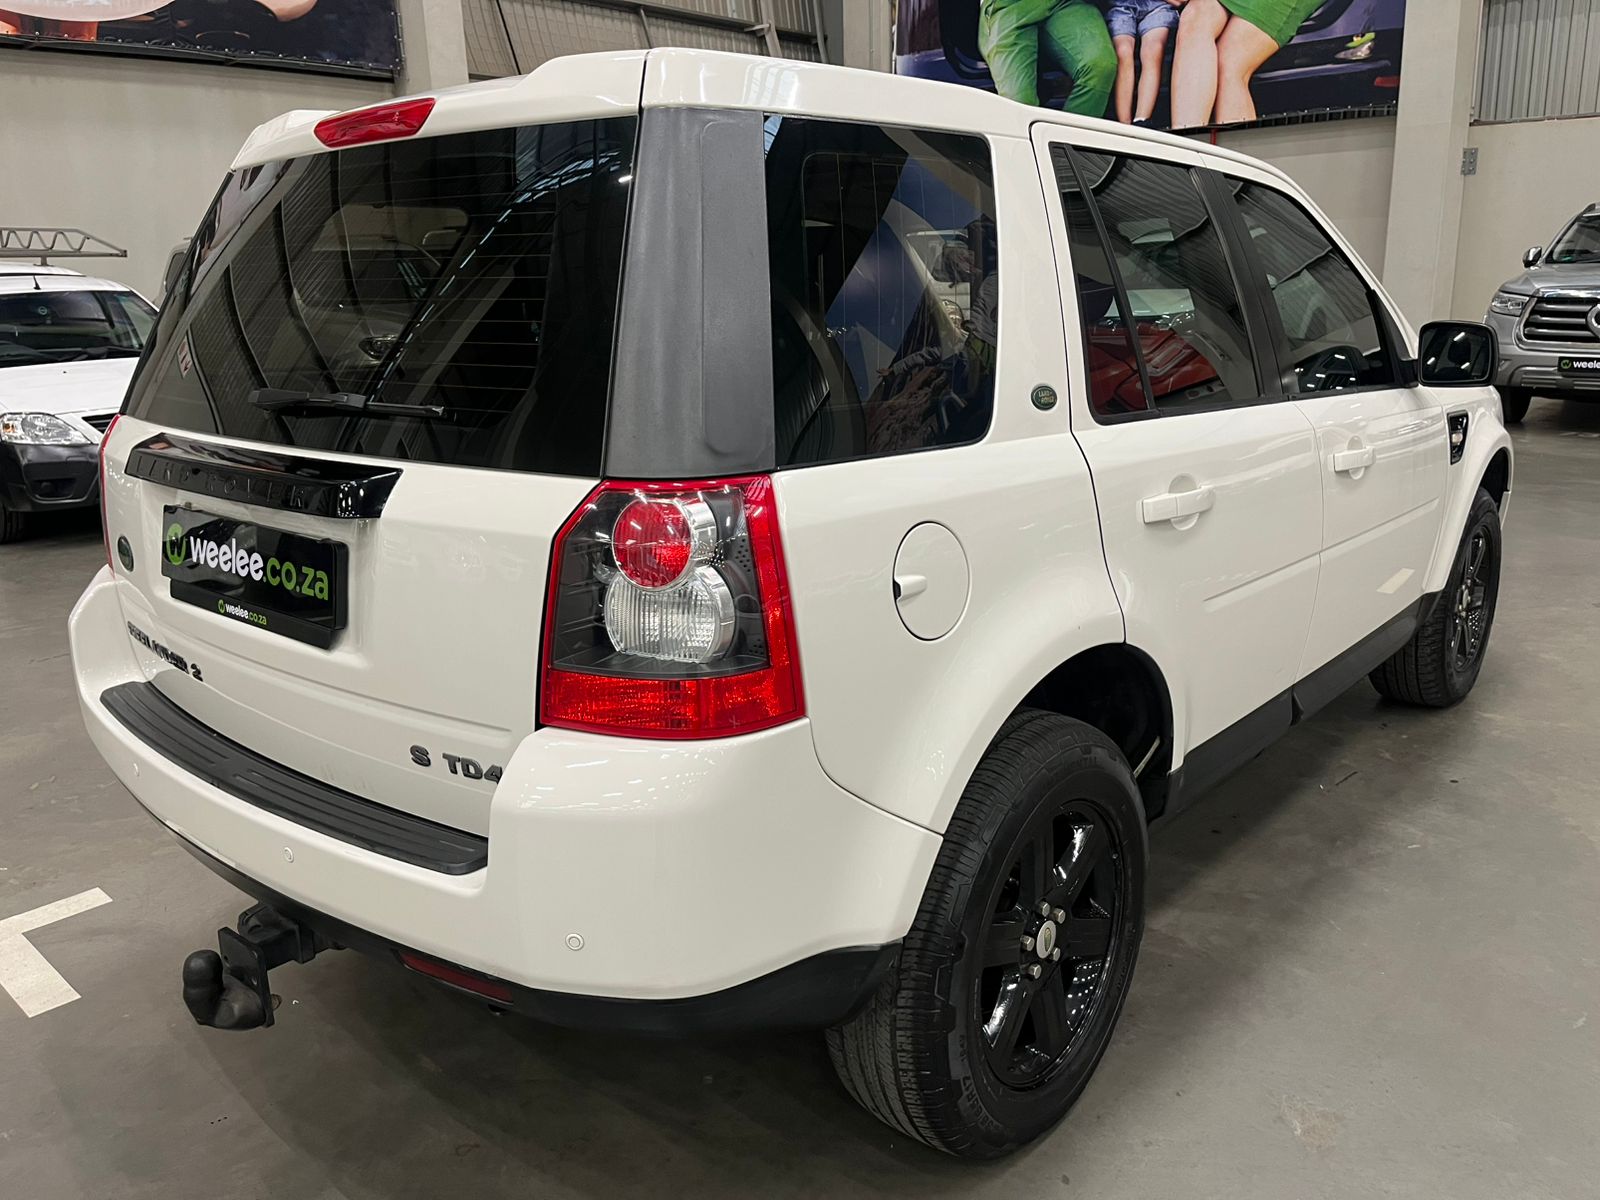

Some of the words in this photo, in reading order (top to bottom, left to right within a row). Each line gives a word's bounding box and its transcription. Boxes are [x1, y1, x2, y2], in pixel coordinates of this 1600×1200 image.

[189, 535, 329, 601] weelee.co.za
[409, 744, 431, 768] S
[442, 752, 503, 785] TD4
